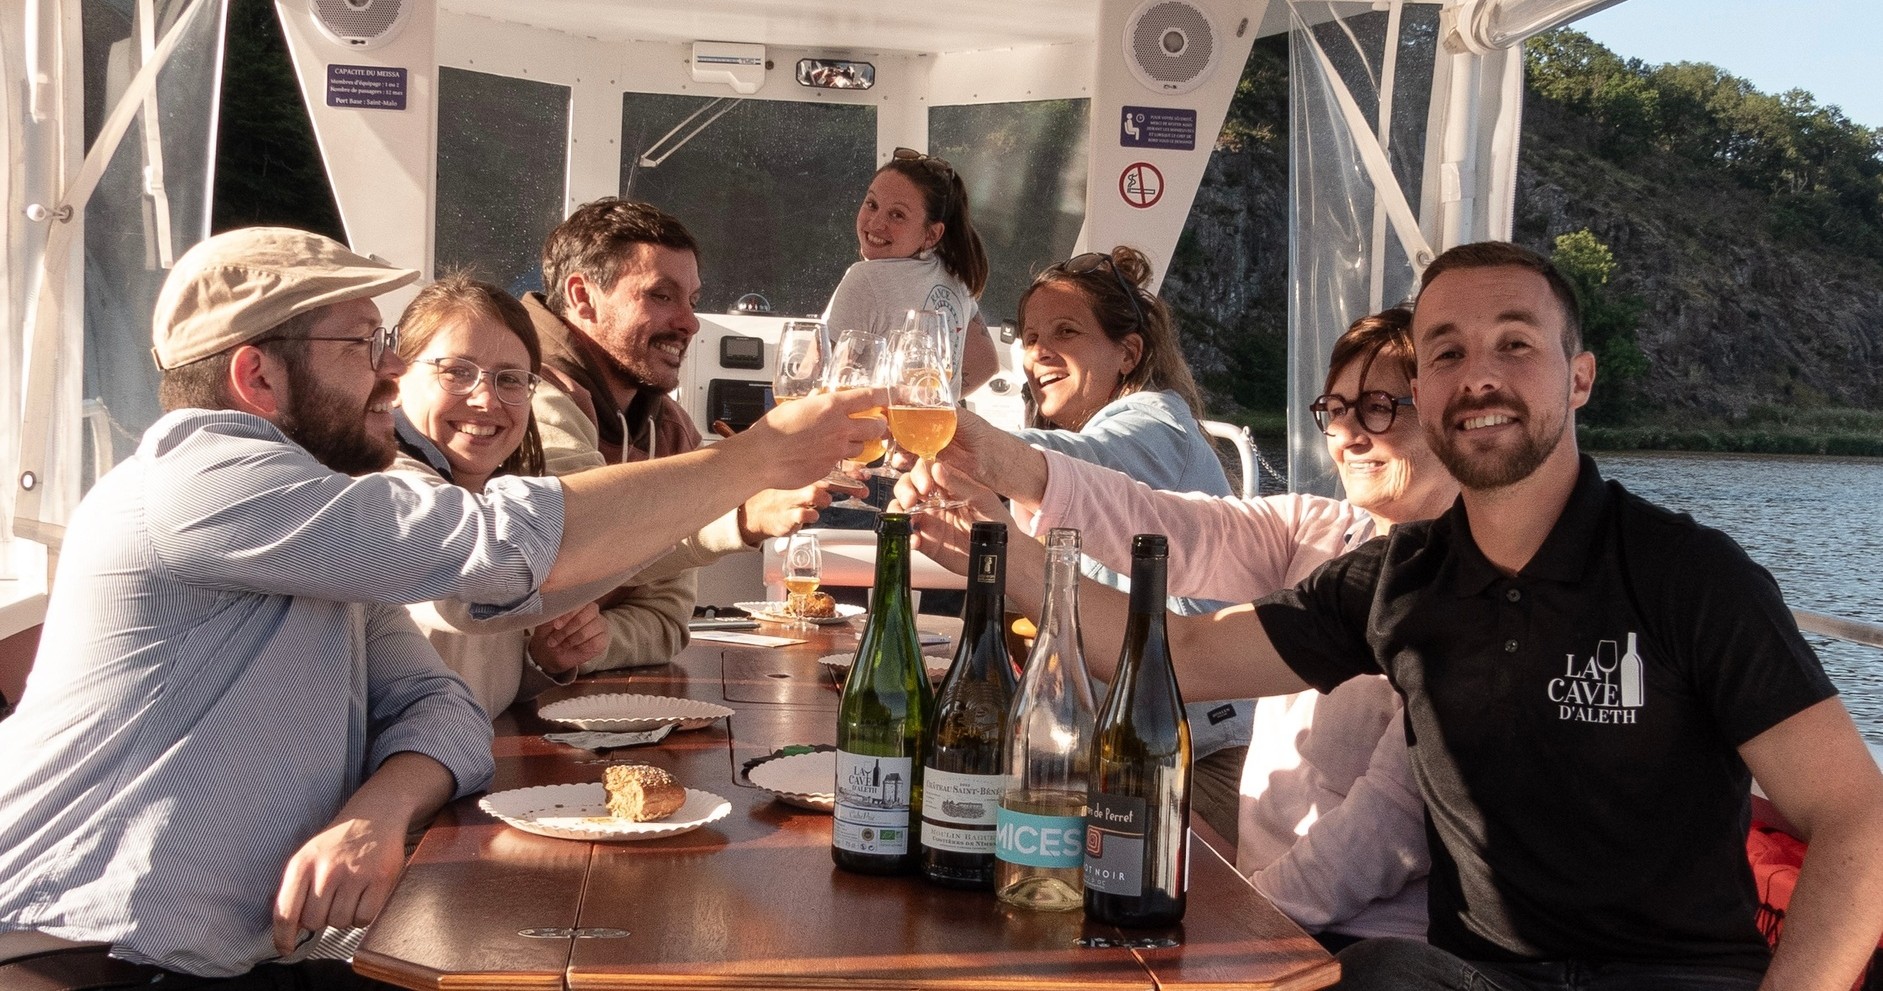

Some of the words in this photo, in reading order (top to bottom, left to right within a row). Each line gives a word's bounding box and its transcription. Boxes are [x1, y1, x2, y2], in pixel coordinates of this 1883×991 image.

[334, 68, 365, 76] CAPACITE
[354, 80, 381, 88] d'équipage
[1564, 653, 1602, 680] LA
[1548, 678, 1620, 707] CAVE
[1558, 704, 1637, 724] D'ALETH
[854, 766, 865, 776] LA
[848, 774, 872, 786] CAVE
[852, 785, 877, 794] D'ALETH
[953, 785, 1001, 796] SAINT-BÉNÉ
[1094, 802, 1104, 818] de
[1105, 807, 1133, 823] Perret
[931, 828, 961, 840] MOULIN
[1095, 868, 1125, 881] NOIR
